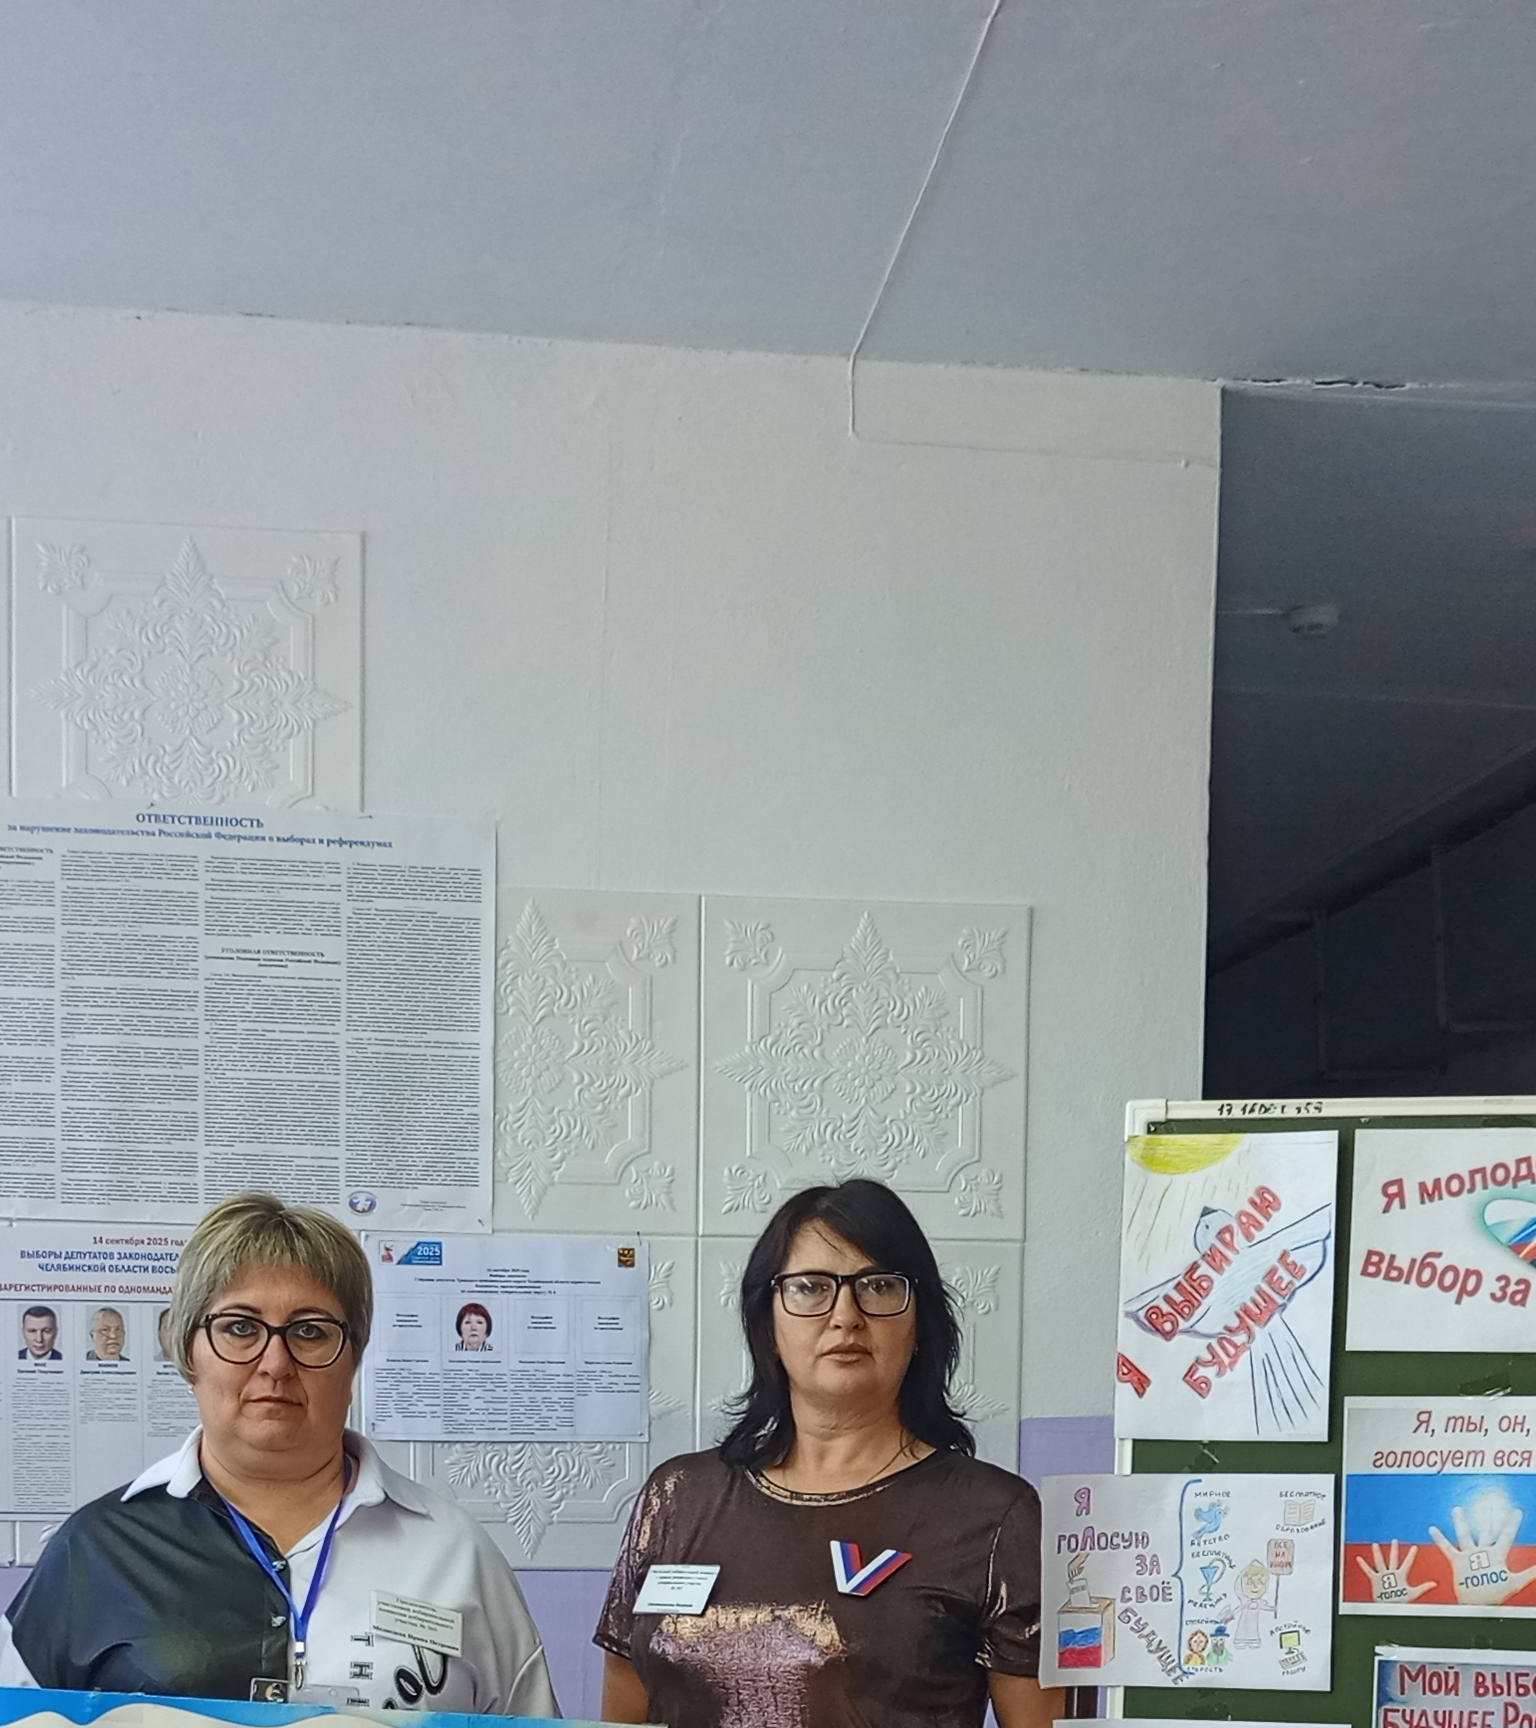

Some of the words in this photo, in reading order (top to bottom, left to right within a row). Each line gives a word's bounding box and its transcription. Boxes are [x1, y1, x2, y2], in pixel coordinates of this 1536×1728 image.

[135, 811, 265, 830] ОТВЕТСТВЕННОСТЬ
[20, 824, 72, 837] нарушение
[73, 826, 157, 840] законодательства
[158, 828, 212, 841] Российской
[214, 830, 266, 844] Федерации
[276, 835, 317, 846] выборах
[326, 837, 393, 851] референдумах
[1381, 1178, 1407, 1214] Я
[92, 1236, 103, 1245] 14
[105, 1237, 145, 1248] сентября
[146, 1237, 169, 1247] 2025
[417, 1246, 440, 1256] 2025
[20, 1250, 63, 1260] ВЫБОРЫ
[64, 1251, 115, 1262] ДЕПУТАТОВ
[38, 1262, 107, 1273] ЧЕЛЯБИНСКОЙ
[108, 1264, 149, 1274] ОБЛАСТИ
[104, 1284, 117, 1293] ПО
[1359, 1248, 1484, 1306] выбор
[1489, 1273, 1532, 1308] за
[1116, 1351, 1152, 1399] Я
[1144, 1185, 1283, 1342] ВЫБИРАЮ
[1412, 1410, 1437, 1438] Я,
[1443, 1412, 1490, 1437] ты,
[1497, 1414, 1531, 1438] он,
[1371, 1449, 1486, 1476] голосует
[1492, 1449, 1533, 1469] вся
[1074, 1486, 1092, 1517] Я
[1134, 1553, 1162, 1577] ЗА
[1468, 1549, 1491, 1572] Я
[1119, 1580, 1174, 1605] СВОЁ
[1380, 1572, 1399, 1590] Я
